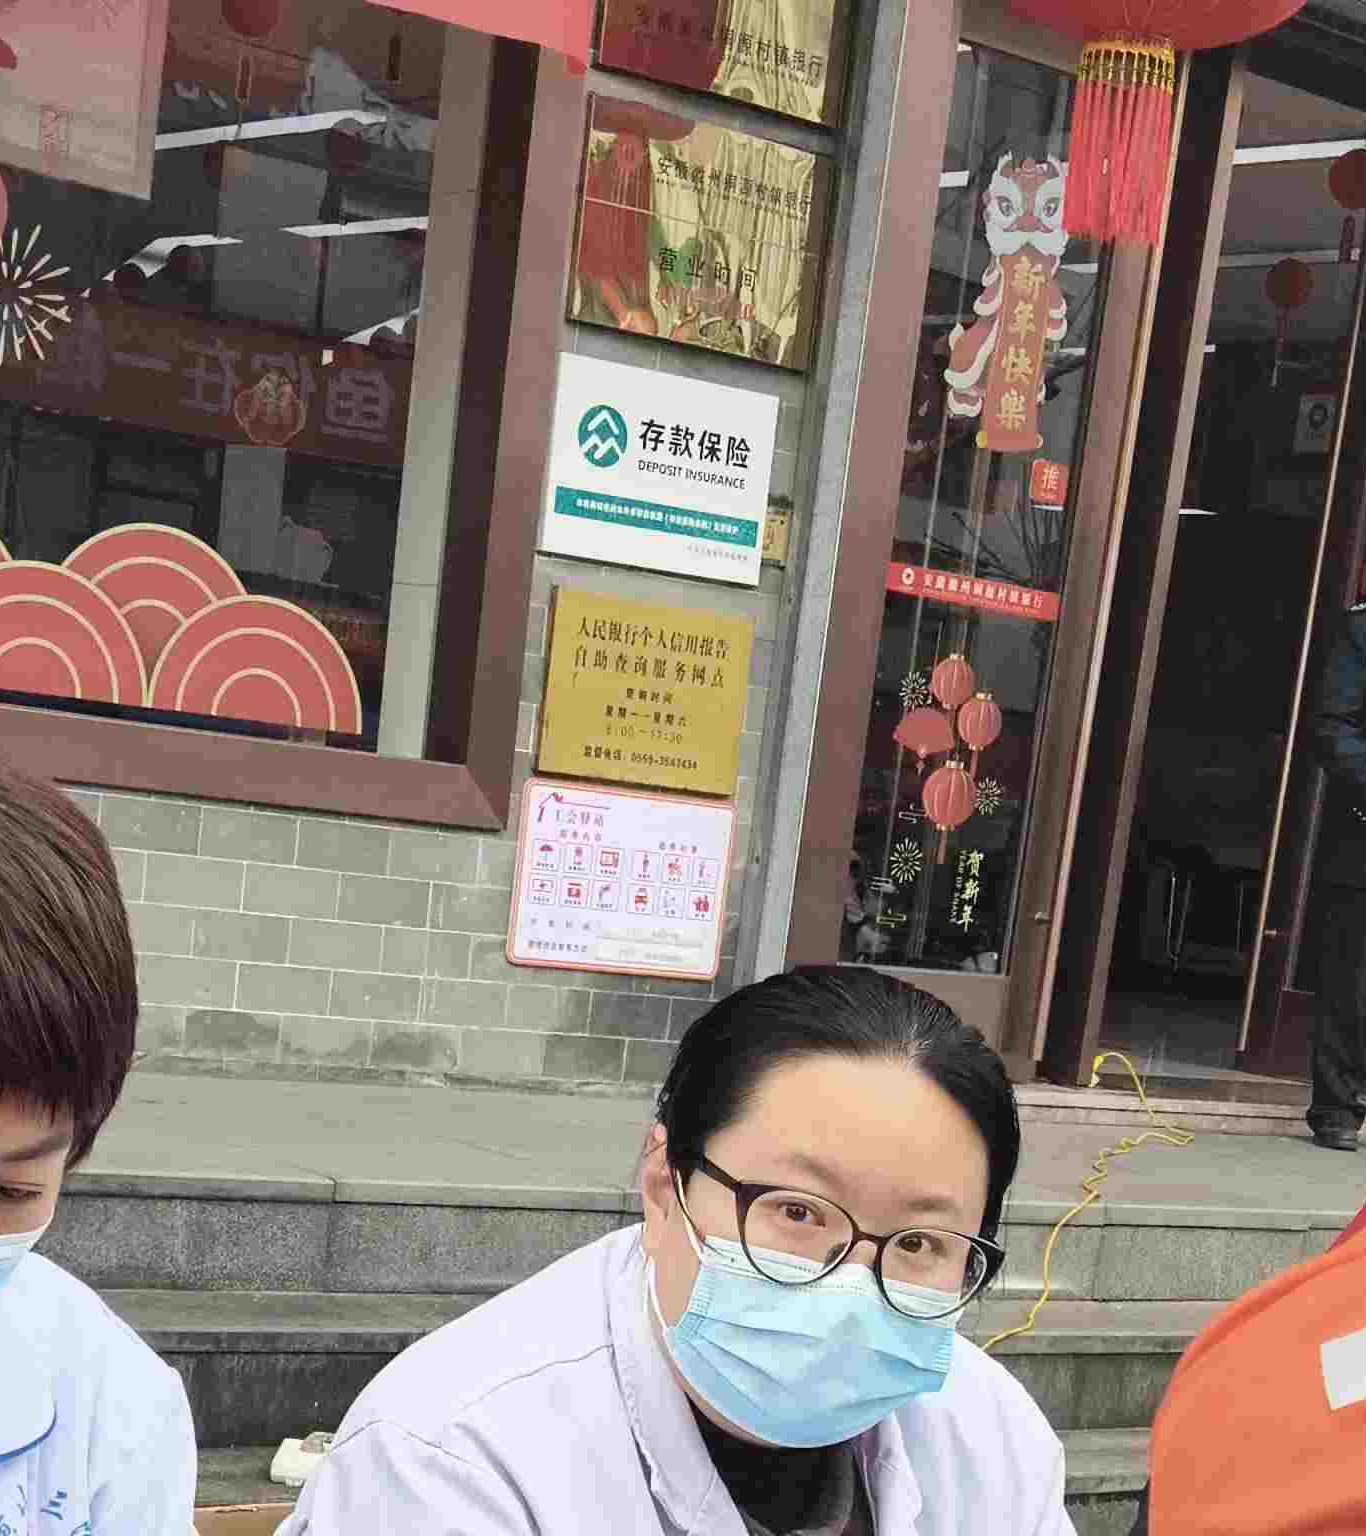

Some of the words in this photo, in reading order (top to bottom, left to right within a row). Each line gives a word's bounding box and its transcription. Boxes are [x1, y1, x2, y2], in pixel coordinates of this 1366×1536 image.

[658, 245, 758, 294] 营业时间
[638, 418, 752, 471] 存款保险
[638, 459, 682, 481] DEPOSIT
[685, 466, 747, 490] INSURANCE
[576, 615, 732, 661] 人民银行个人信用报告
[574, 645, 725, 689] 自助查询服务网点
